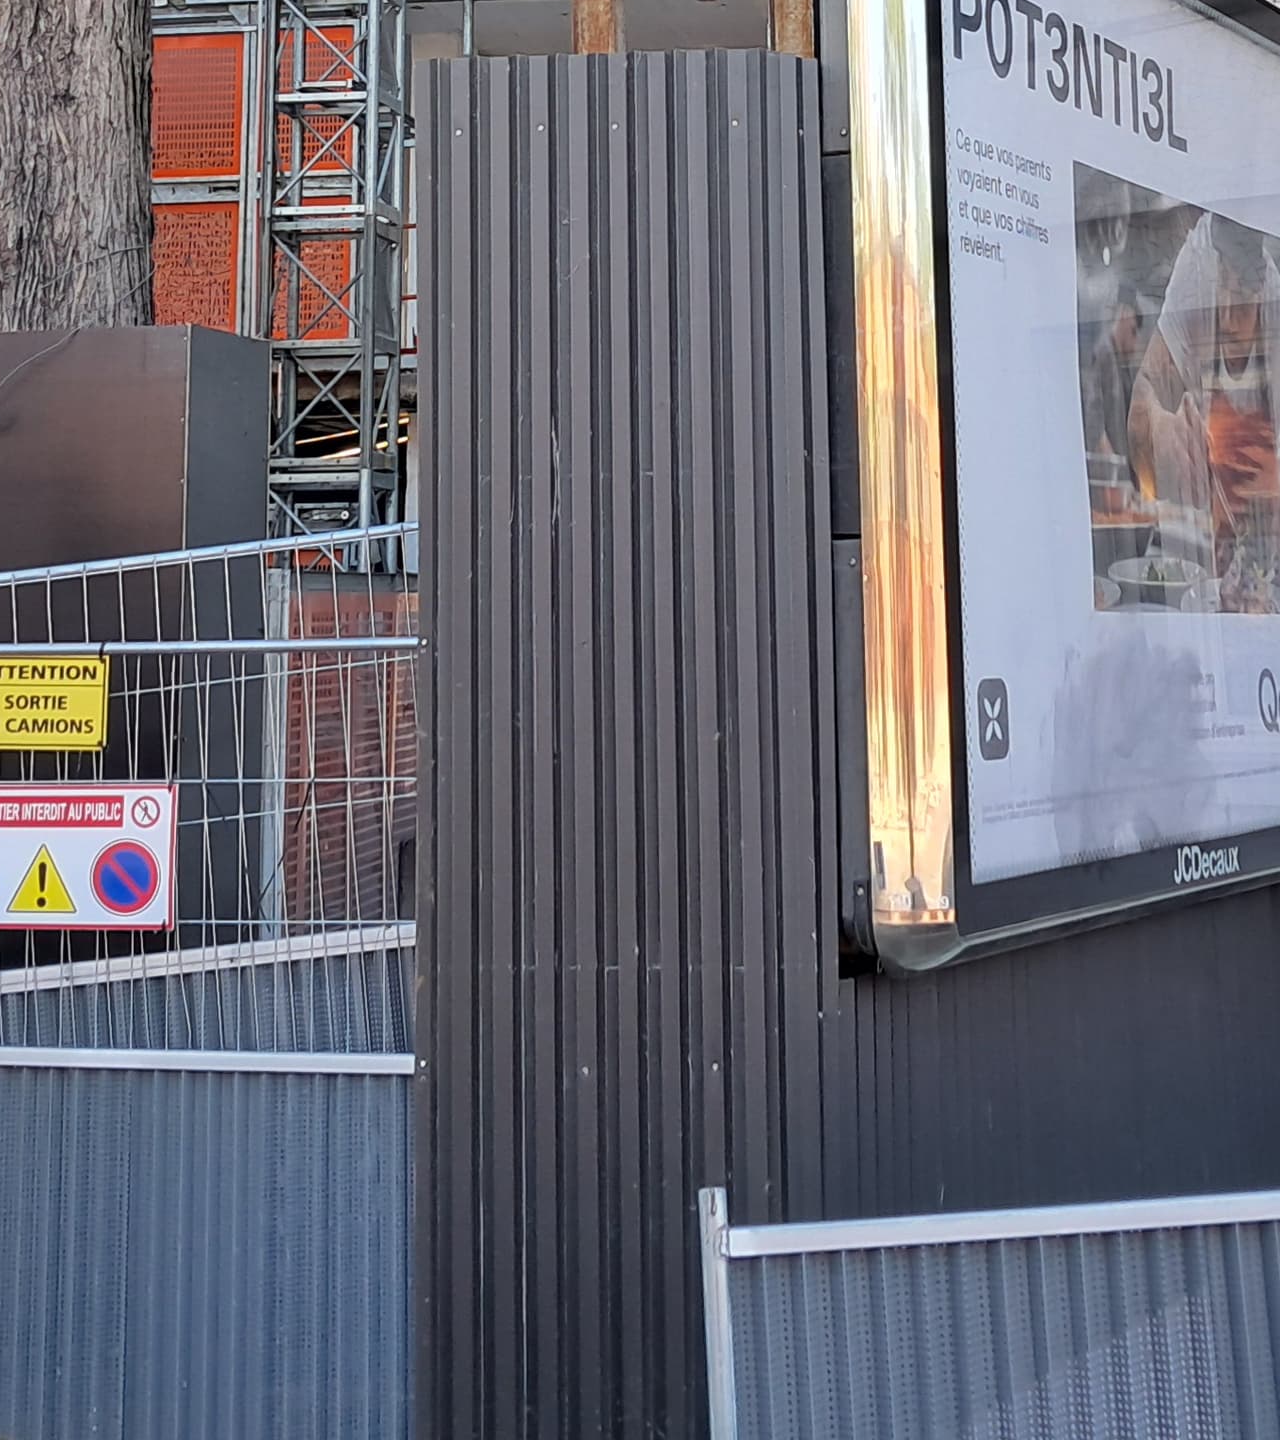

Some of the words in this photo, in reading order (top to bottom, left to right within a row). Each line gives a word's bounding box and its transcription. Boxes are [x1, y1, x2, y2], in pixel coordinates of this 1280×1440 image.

[955, 127, 971, 153] Ce
[973, 138, 994, 162] que
[996, 146, 1014, 168] vos
[1015, 153, 1052, 182] parents
[957, 167, 1003, 197] voyaient
[1005, 182, 1018, 201] en
[1019, 187, 1040, 210] vous
[958, 199, 969, 220] et
[971, 205, 992, 229] que
[994, 211, 1014, 233] vos
[4, 694, 68, 711] SORTIE
[5, 718, 94, 735] CAMIONS
[21, 802, 67, 821] INTERDIT
[68, 802, 83, 821] AU
[84, 801, 121, 821] PUBLIC
[1173, 844, 1241, 885] JCDecaux
